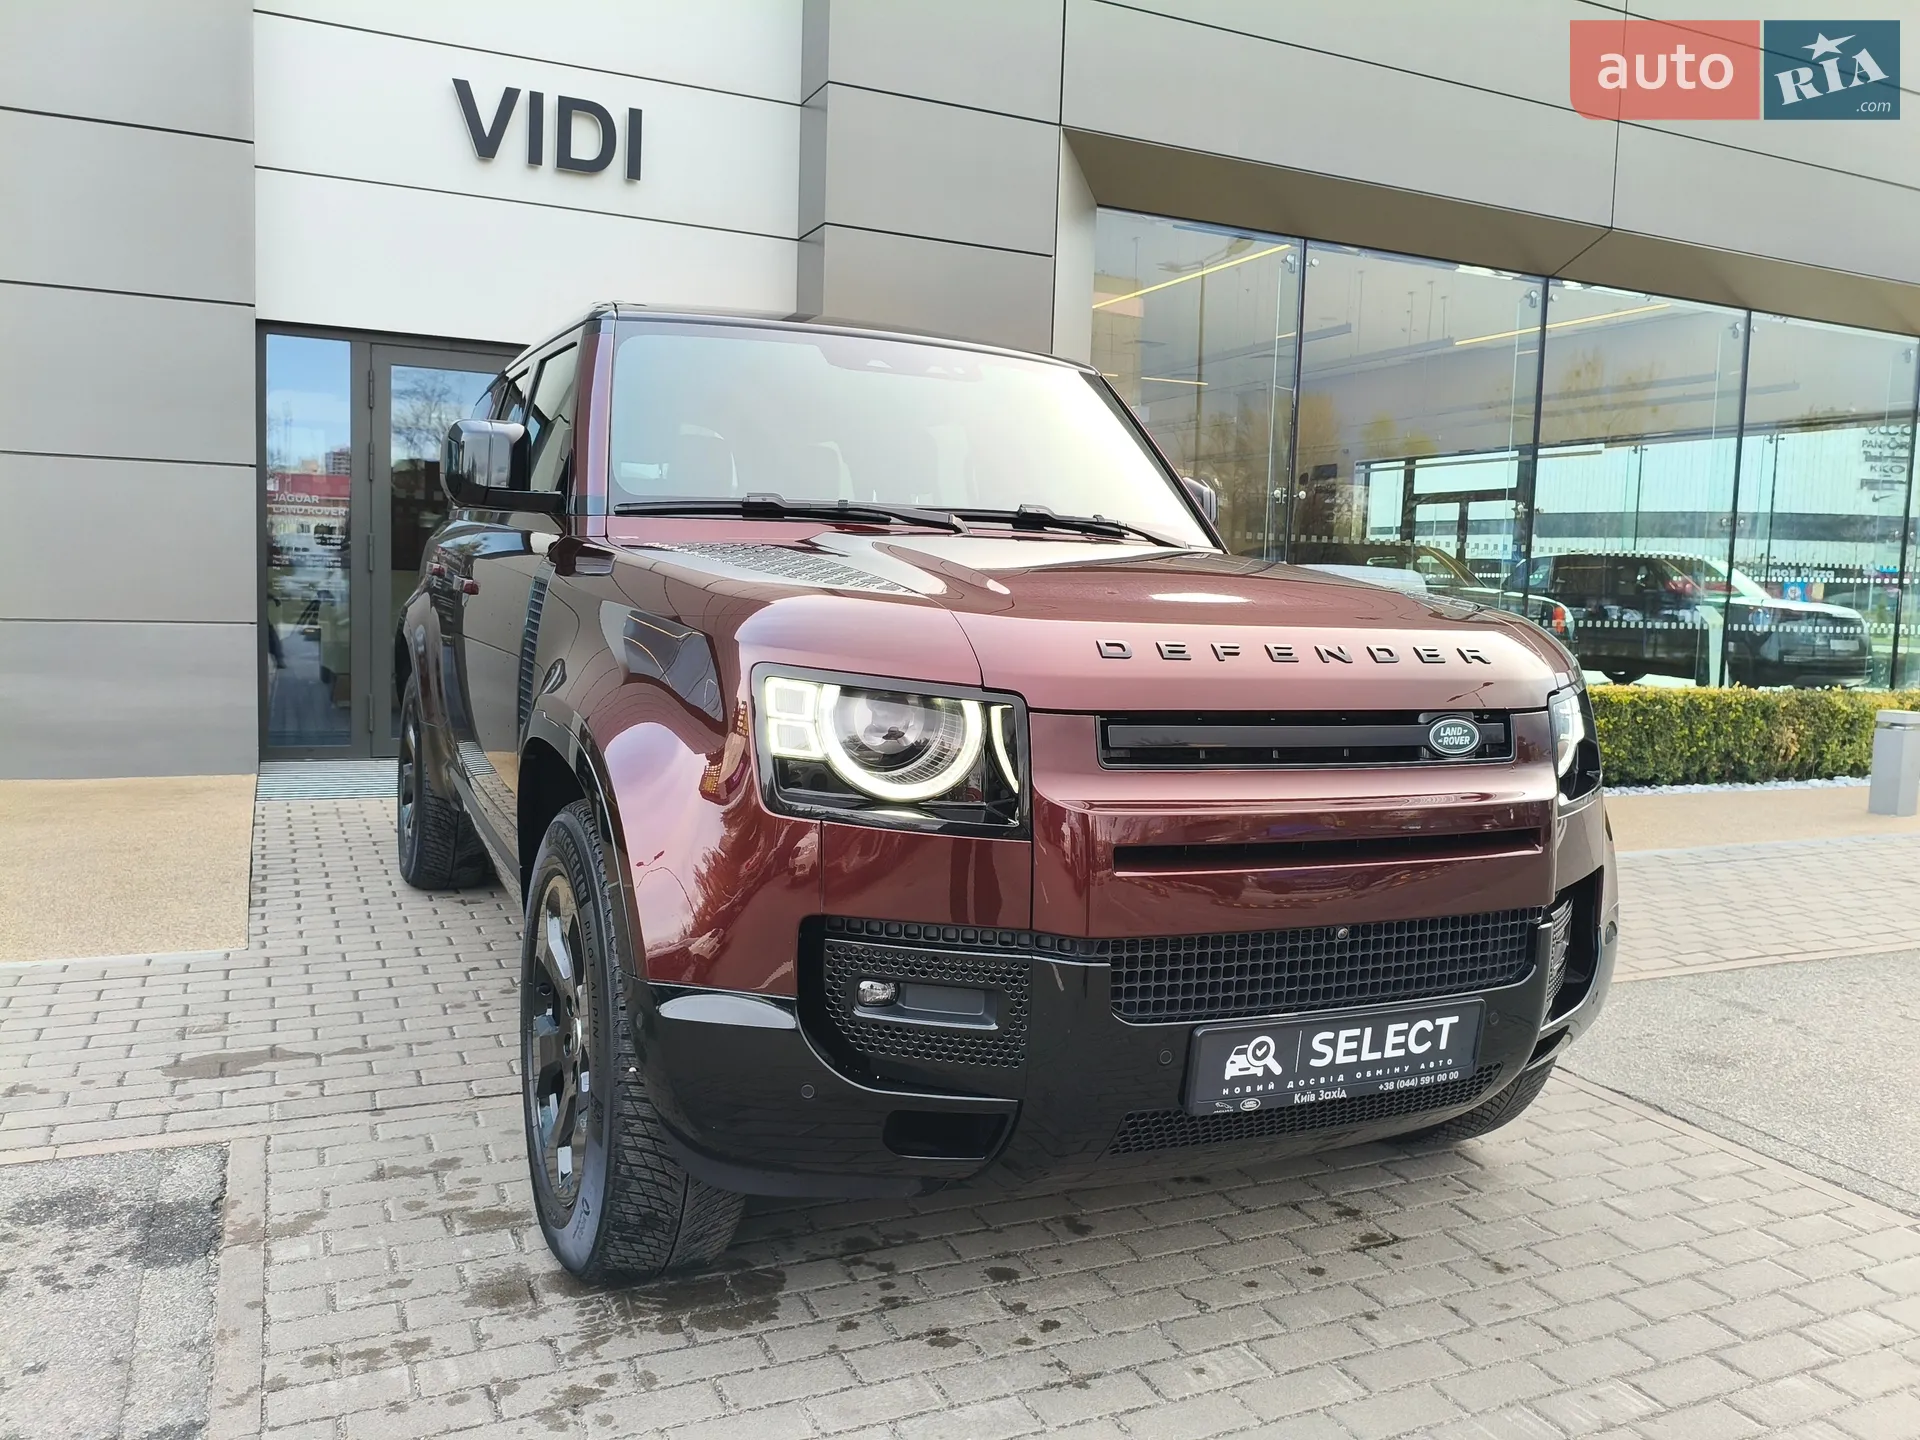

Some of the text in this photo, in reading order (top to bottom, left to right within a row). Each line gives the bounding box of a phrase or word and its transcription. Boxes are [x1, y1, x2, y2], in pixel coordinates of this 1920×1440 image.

[451, 77, 643, 181] VIDI
[272, 493, 320, 504] JAGUAR
[272, 505, 347, 516] LAND ROVER
[1096, 639, 1491, 664] DEFENDER
[1440, 726, 1463, 737] LAND
[1442, 735, 1471, 746] ROVER
[1309, 1015, 1460, 1068] SELECT
[1222, 1058, 1453, 1096] НОВИЙ ДОСВІД ОБМІНУ АВТО
[1378, 1070, 1460, 1092] +38 (044) 591 00 00
[1293, 1087, 1348, 1105] Київ Захід
